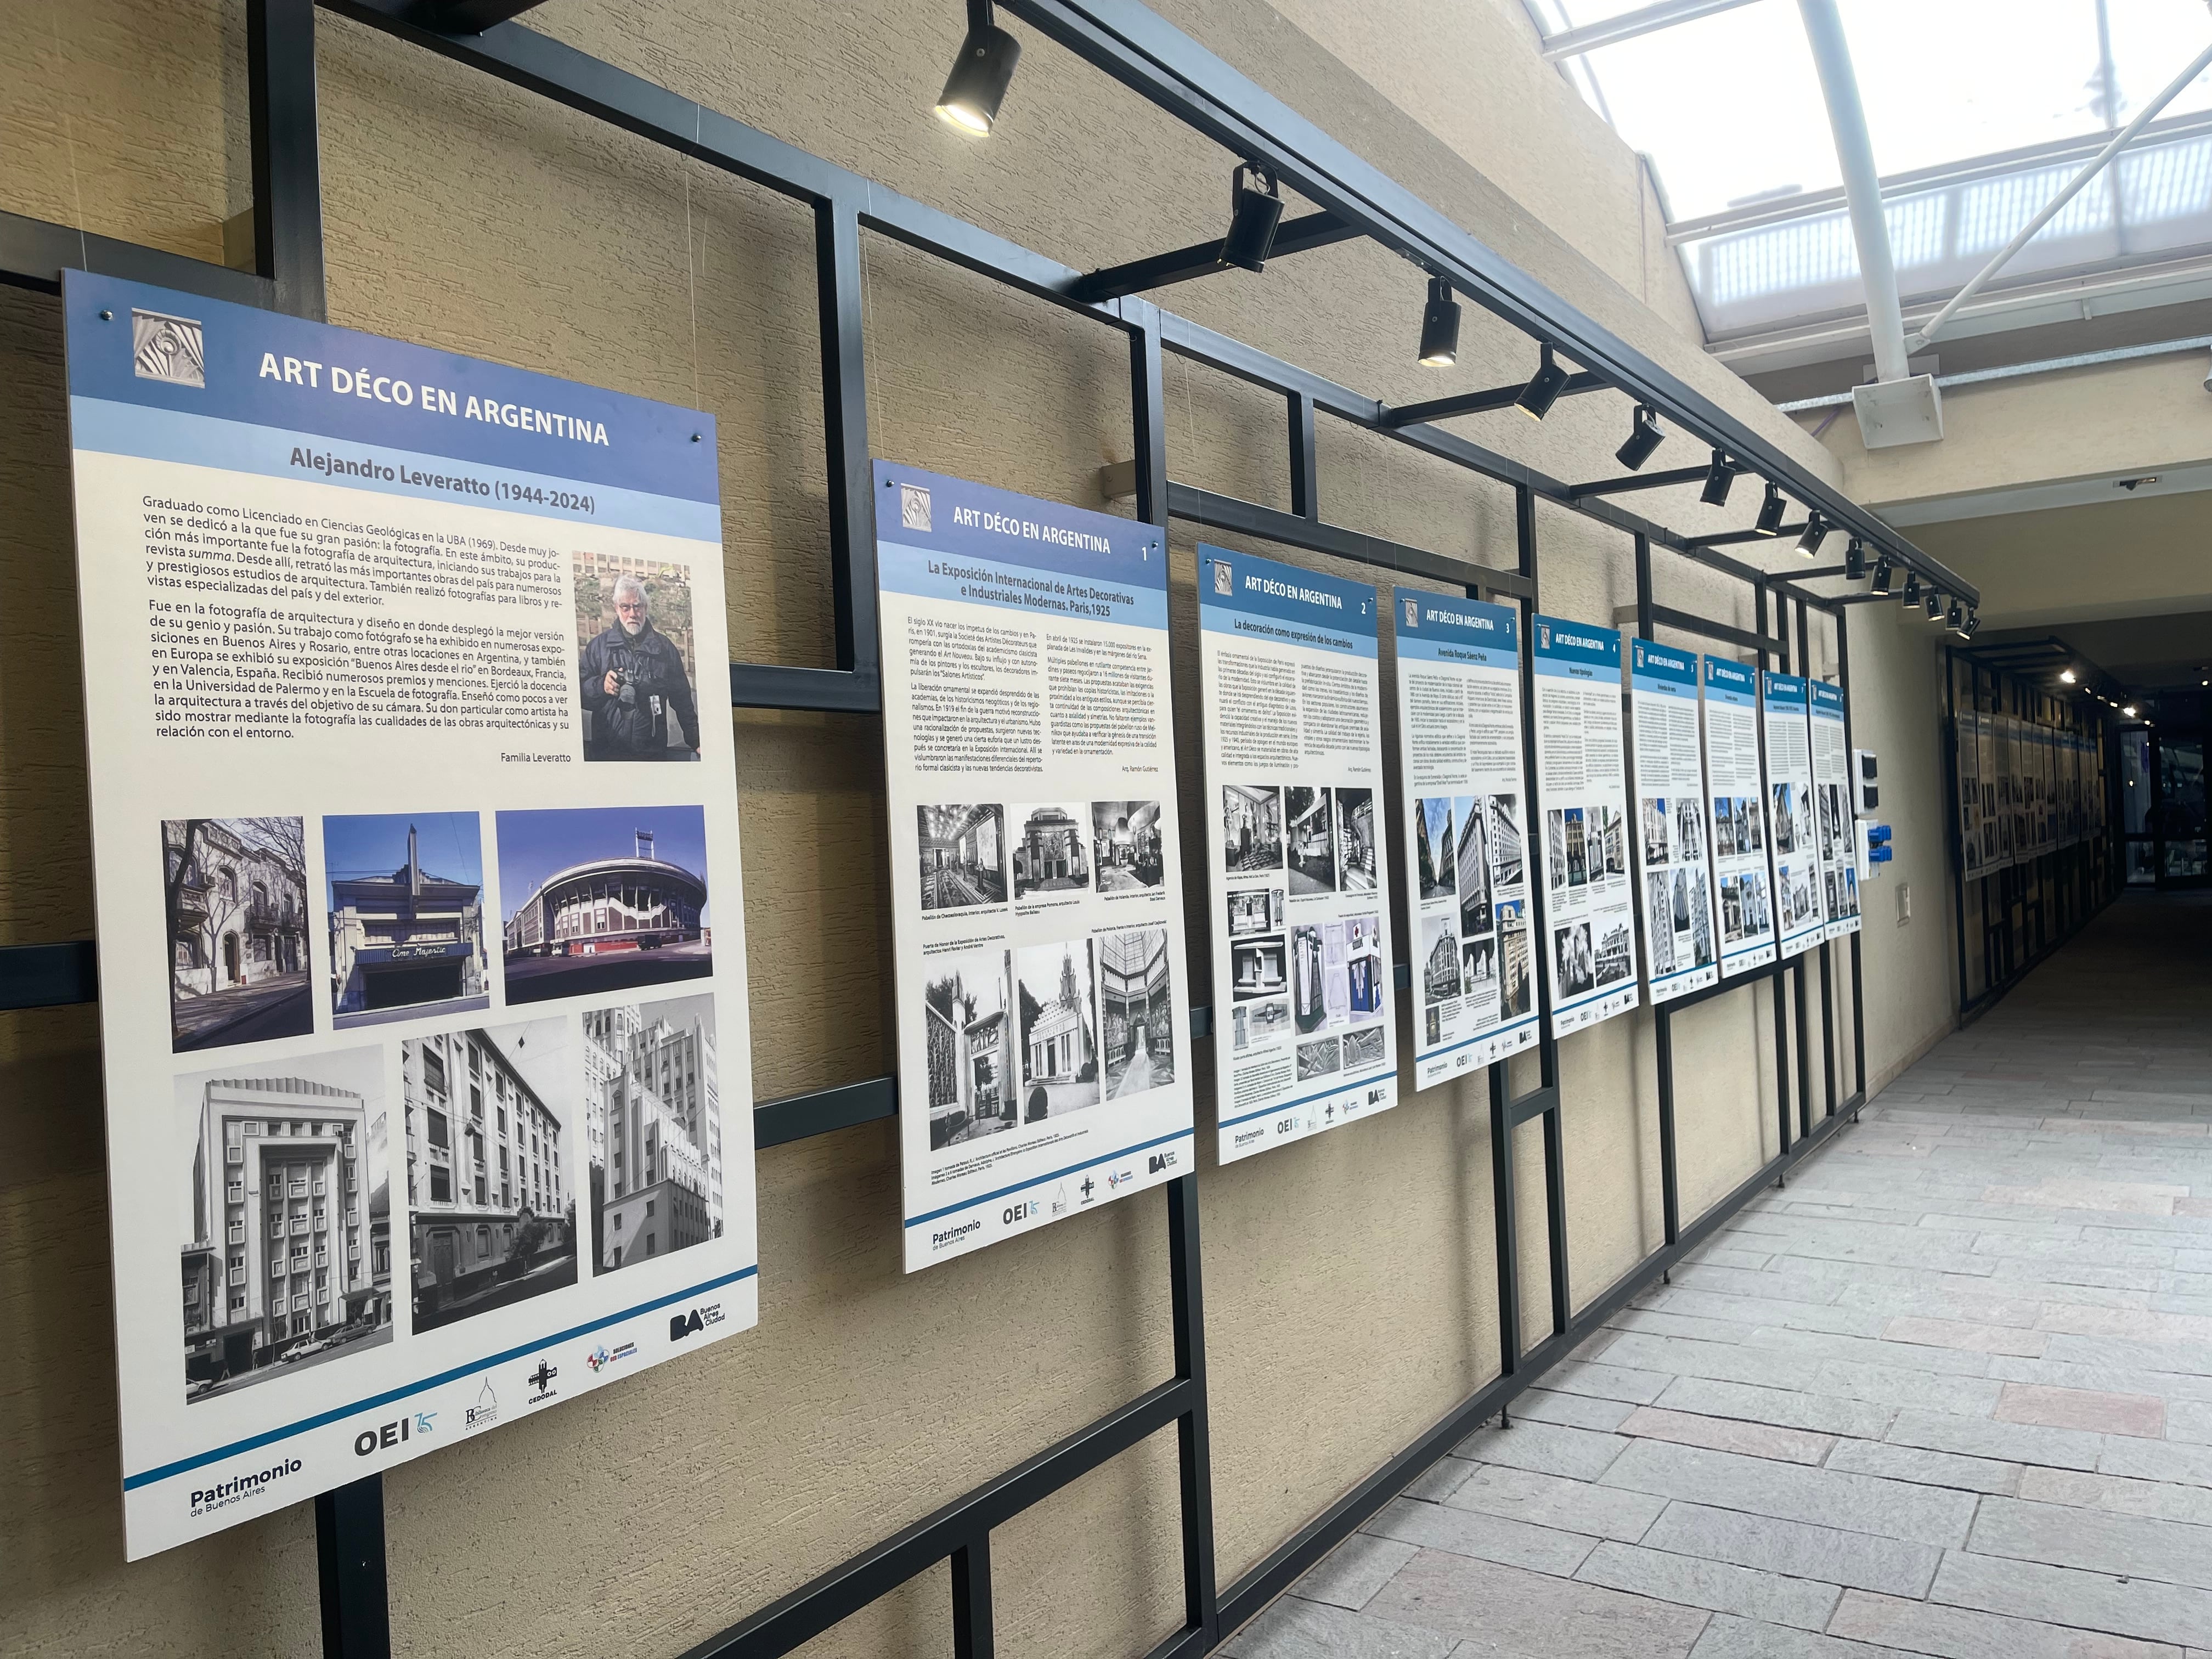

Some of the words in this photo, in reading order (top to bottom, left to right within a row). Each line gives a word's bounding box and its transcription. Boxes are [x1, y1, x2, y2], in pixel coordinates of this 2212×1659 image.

[259, 352, 323, 388] ART
[331, 366, 414, 406] DÉCO
[421, 385, 457, 416] EN
[465, 396, 610, 447] ARGENTINA
[290, 447, 395, 481] Alejandro
[400, 465, 490, 496] Leveratto
[495, 480, 595, 515] (1944-2024)
[143, 495, 204, 513] Graduado
[206, 506, 240, 518] como
[242, 507, 302, 525] Licenciado
[304, 518, 318, 527] en
[321, 518, 364, 533] Ciencias
[366, 524, 420, 540] Geológicas
[422, 533, 434, 541] en
[436, 532, 444, 543] la
[447, 534, 466, 546] UBA
[468, 537, 498, 550] (1969).
[500, 541, 527, 554] Desde
[528, 547, 546, 556] muy
[549, 548, 559, 557] jo-
[953, 506, 981, 528] ART
[984, 511, 1020, 536] DÉCO
[1022, 521, 1039, 540] EN
[1042, 525, 1111, 554] ARGENTINA
[143, 514, 166, 524] ven
[170, 517, 183, 527] se
[187, 516, 227, 531] dedicó
[231, 524, 238, 532] a
[241, 522, 251, 534] la
[255, 527, 276, 537] que
[279, 526, 298, 539] fue
[301, 532, 313, 541] su
[316, 534, 340, 544] gran
[343, 537, 380, 550] pasión:
[383, 539, 391, 551] la
[394, 539, 443, 556] fotografía.
[445, 548, 456, 558] En
[460, 552, 478, 561] este
[481, 552, 514, 566] ámbito,
[528, 557, 560, 570] produc-
[1142, 546, 1147, 561] 1
[928, 560, 940, 574] La
[942, 562, 993, 583] Exposición
[995, 572, 1053, 593] Internacional
[1054, 581, 1065, 595] de
[1066, 583, 1088, 599] Artes
[1089, 587, 1135, 606] Decorativas
[1245, 575, 1262, 591] ART
[1263, 578, 1286, 597] DÉCO
[1287, 584, 1298, 600] EN
[1299, 588, 1342, 610] ARGENTINA
[961, 586, 967, 596] e
[968, 584, 1023, 605] Industriales
[1024, 592, 1069, 611] Modernas.
[1069, 600, 1110, 617] Paris,1925
[1361, 602, 1366, 614] 2
[1234, 618, 1242, 629] La
[1242, 619, 1274, 635] decoración
[1274, 628, 1290, 638] como
[1290, 631, 1317, 643] expresión
[1317, 634, 1324, 644] de
[1324, 634, 1332, 646] los
[1332, 638, 1353, 650] cambios
[1426, 609, 1438, 622] ART
[1439, 610, 1455, 624] DÉCO
[1455, 613, 1464, 626] EN
[1464, 615, 1494, 631] ARGENTINA
[1506, 623, 1510, 634] 3
[1555, 633, 1565, 644] ART
[1564, 633, 1576, 646] DÉCO
[1576, 636, 1582, 647] EN
[1582, 637, 1604, 651] ARGENTINA
[501, 752, 531, 762] Familia
[532, 753, 571, 762] Leveratto
[1277, 1118, 1293, 1135] OEI
[1003, 1203, 1028, 1225] OEI
[933, 1219, 981, 1245] Patrimonio
[700, 1303, 720, 1315] Buenos
[703, 1310, 719, 1321] Aires
[705, 1312, 725, 1327] Ciudad
[670, 1308, 704, 1342] BA
[528, 1389, 557, 1404] CEDODAL
[354, 1417, 409, 1457] OEI
[191, 1458, 302, 1508] Patrimonio
[190, 1508, 203, 1517] de
[206, 1494, 240, 1513] Buenos
[242, 1486, 265, 1499] Aires
